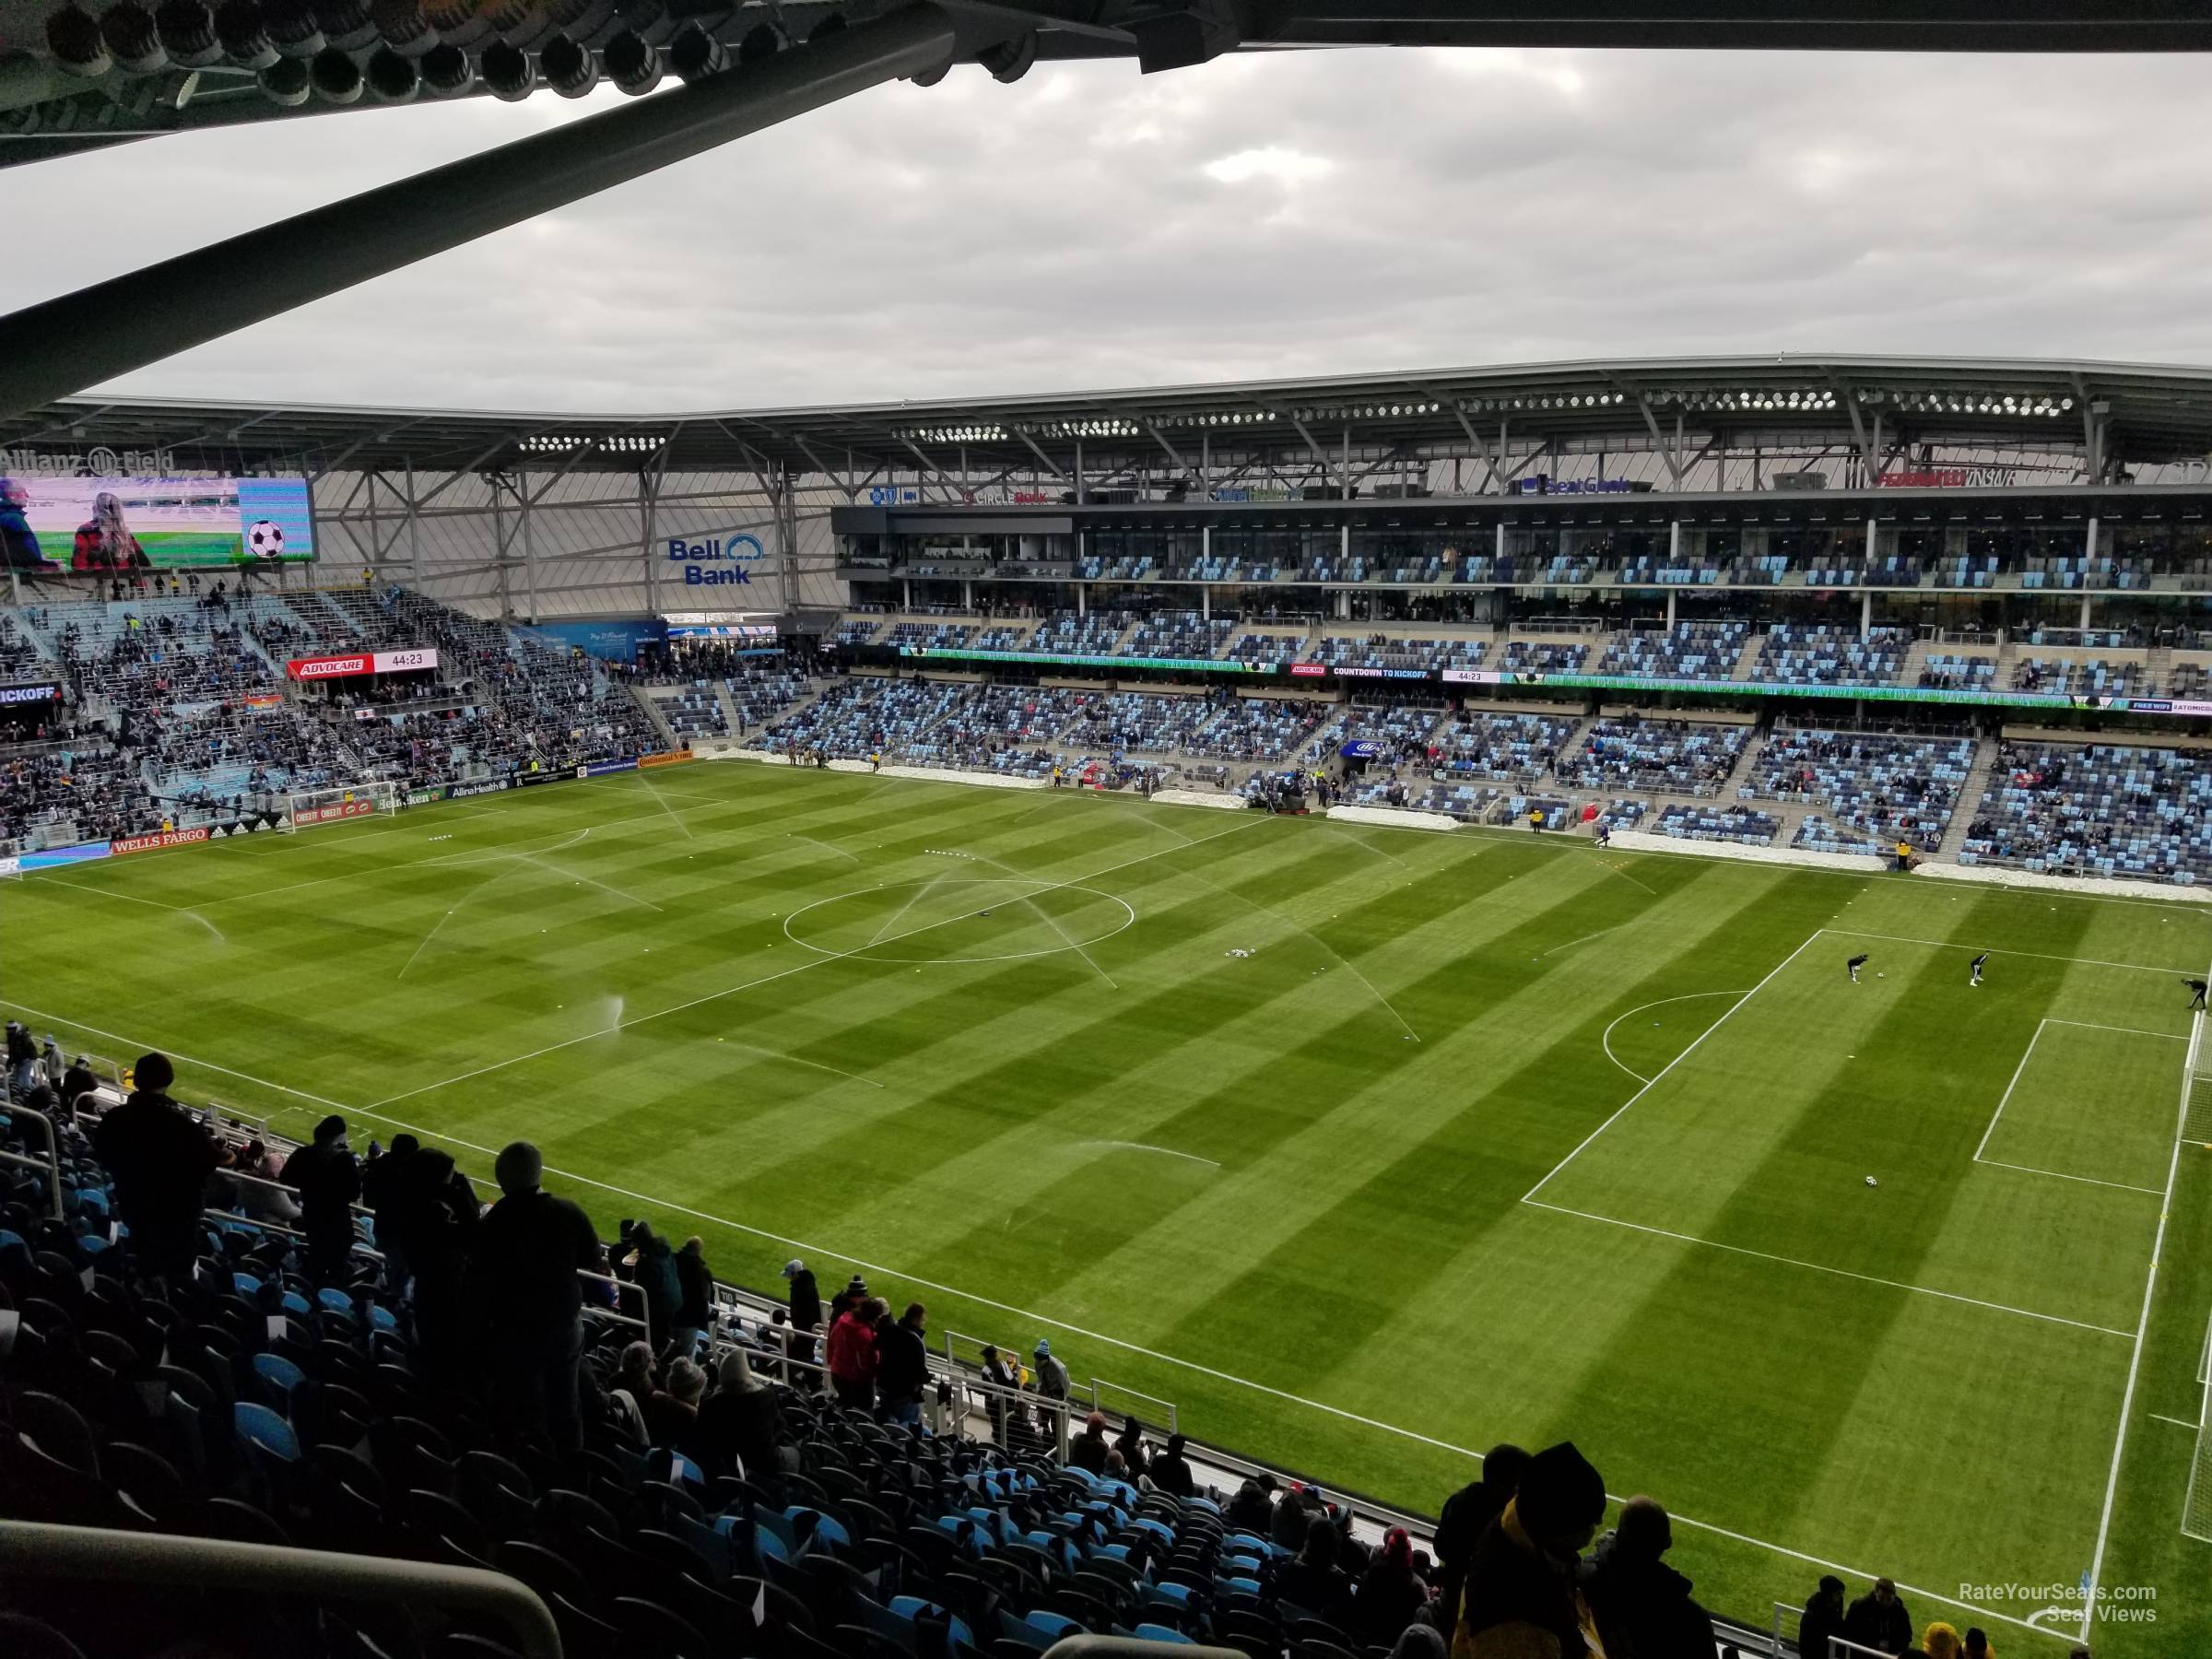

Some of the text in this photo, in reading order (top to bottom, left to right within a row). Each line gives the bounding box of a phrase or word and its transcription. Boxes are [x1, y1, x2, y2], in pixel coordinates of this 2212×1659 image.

[0, 449, 174, 471] Allianz Field
[976, 493, 1015, 506] CIRCLE
[668, 539, 721, 560] Bell
[685, 565, 751, 584] Bank
[300, 659, 363, 675] ADVOCARE
[393, 653, 423, 665] 44:23
[1334, 667, 1427, 679] COUNTDOWN TO KICKOFF
[1458, 672, 1481, 681] 44:23
[639, 754, 673, 767] Continental
[453, 782, 499, 798] Allina Health
[115, 830, 206, 853] WELLS FARGO
